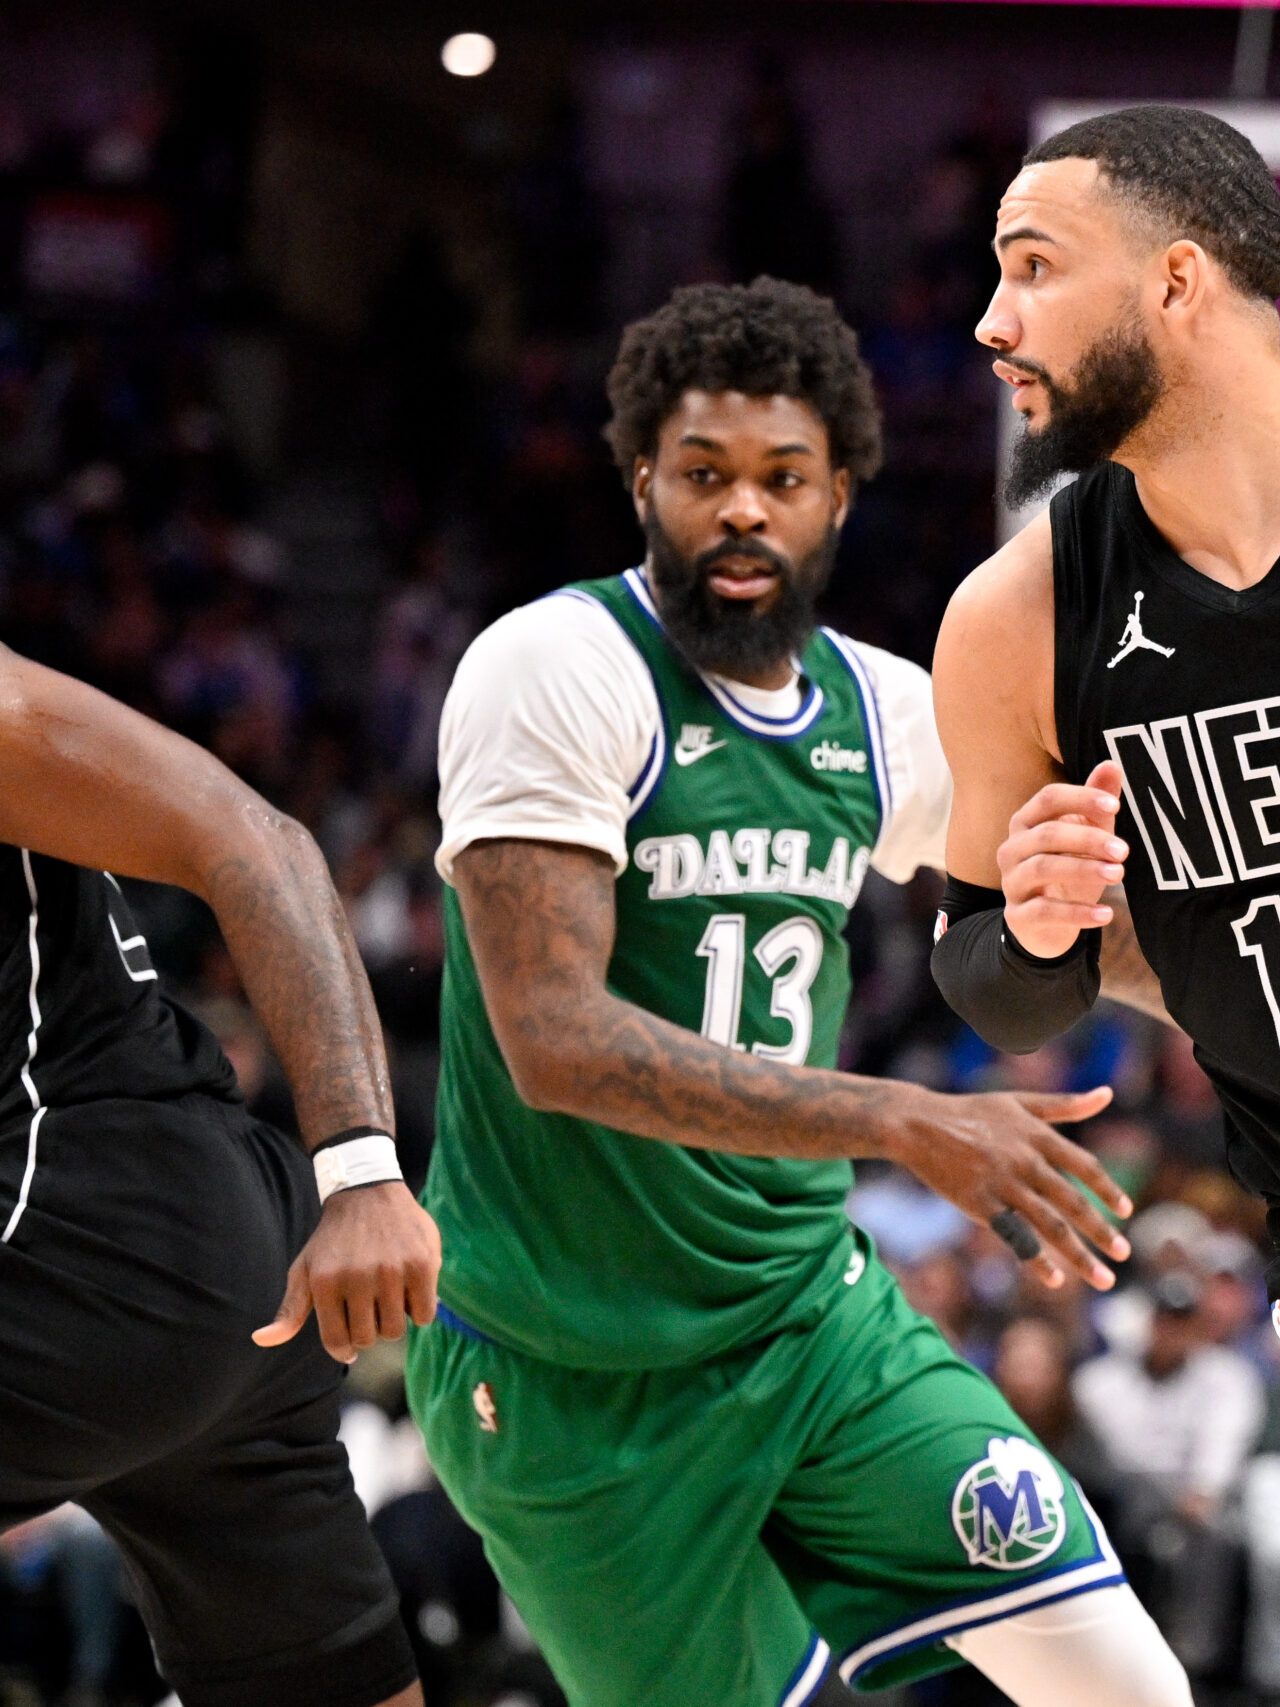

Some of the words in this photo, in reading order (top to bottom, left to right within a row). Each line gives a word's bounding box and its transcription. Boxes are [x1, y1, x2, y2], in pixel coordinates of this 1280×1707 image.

[811, 740, 867, 773] chime
[695, 914, 824, 1067] 13
[972, 1469, 1051, 1555] M
